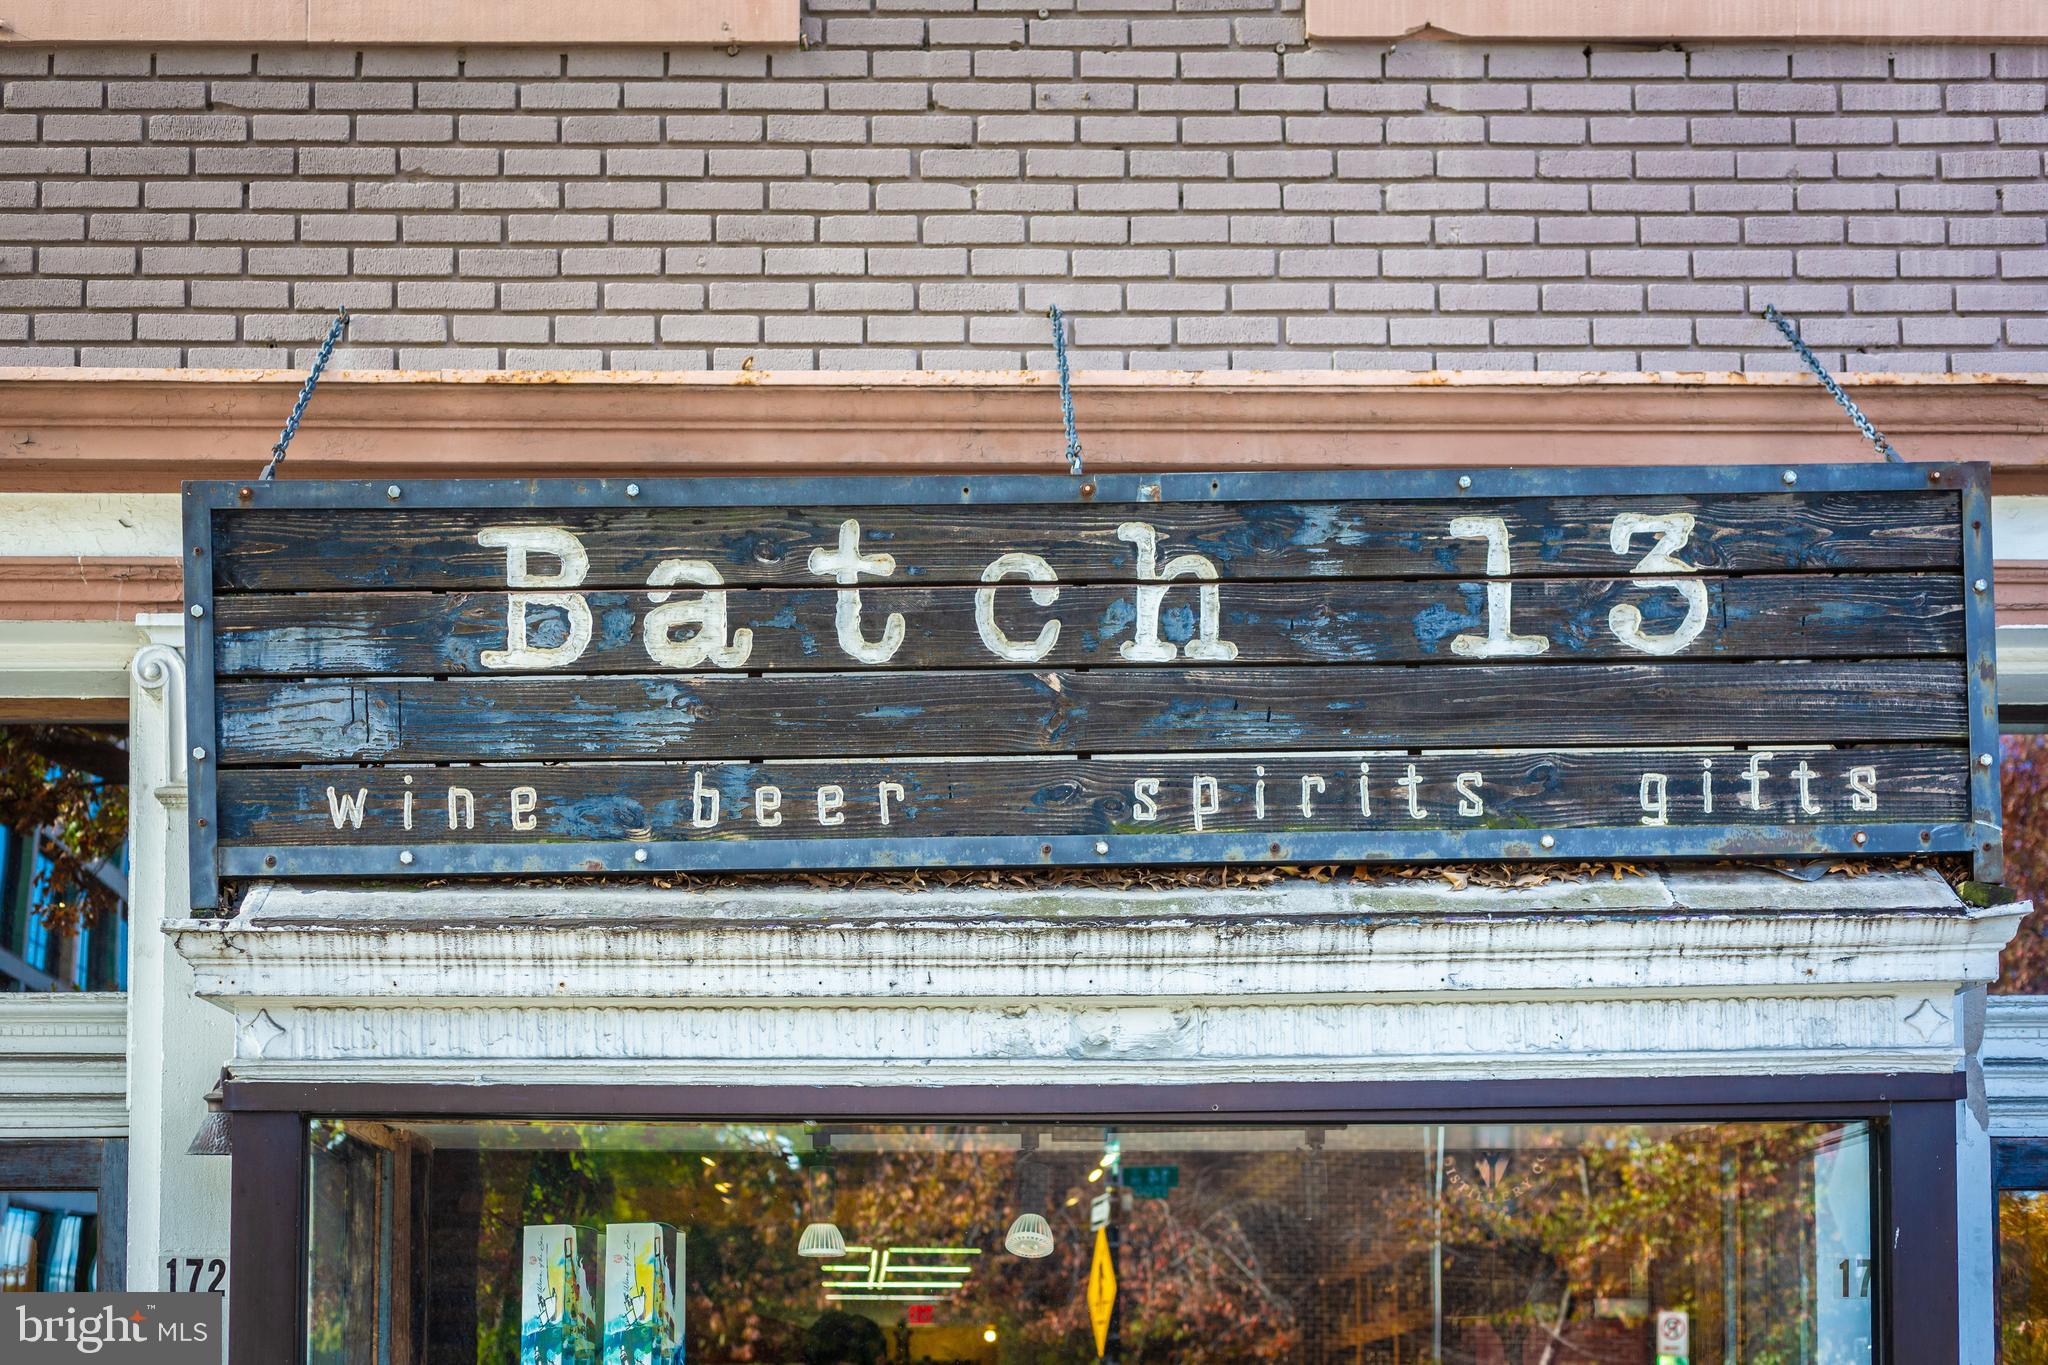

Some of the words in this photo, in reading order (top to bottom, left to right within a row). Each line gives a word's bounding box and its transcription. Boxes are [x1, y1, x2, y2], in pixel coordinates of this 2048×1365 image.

[477, 517, 1238, 669] Batch
[1449, 511, 1709, 660] 13
[326, 774, 537, 831] wine
[692, 771, 906, 828] beer
[1132, 762, 1484, 832] spirits
[1639, 751, 1879, 826] gifts
[166, 1257, 226, 1297] 172
